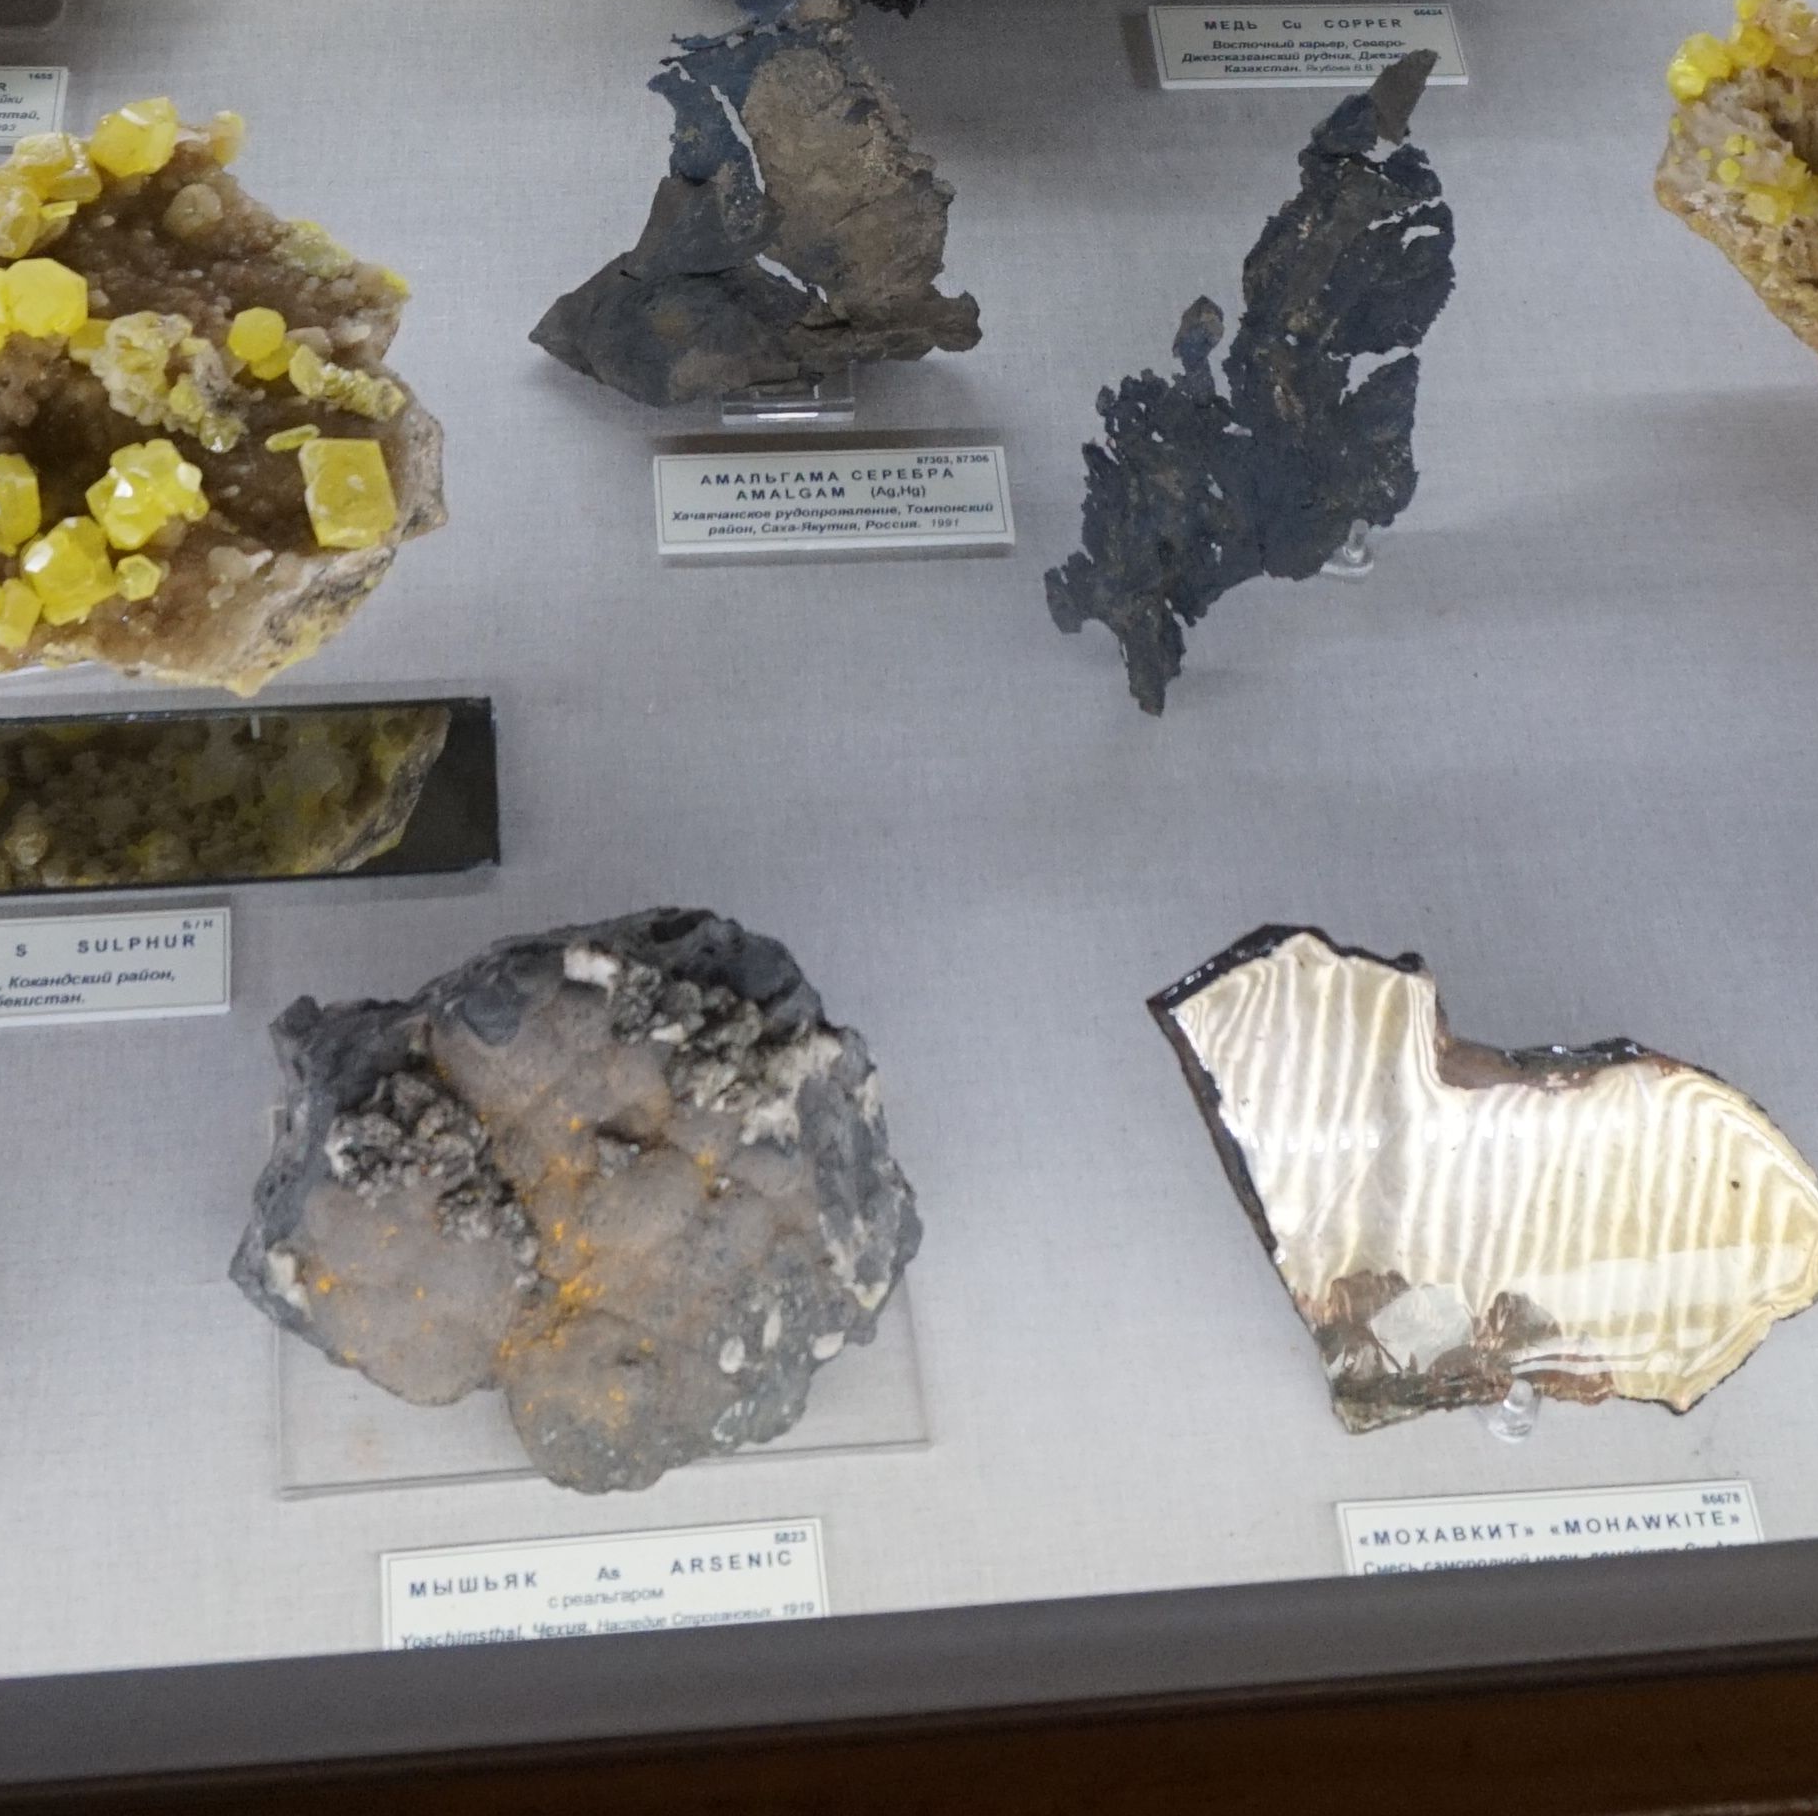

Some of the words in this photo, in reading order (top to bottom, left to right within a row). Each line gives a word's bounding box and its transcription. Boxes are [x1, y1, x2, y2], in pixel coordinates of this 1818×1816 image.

[1204, 20, 1258, 31] МЕДЬ
[1282, 19, 1302, 29] Cu
[1324, 18, 1403, 29] COPPER
[1212, 39, 1295, 50] Восточный
[1224, 64, 1301, 74] Казахстан.
[700, 470, 840, 485] АМАЛЬГАМА
[851, 468, 954, 481] СЕРЕБРА
[736, 486, 846, 501] AMALGAM
[708, 524, 757, 537] район,
[15, 943, 28, 958] S
[77, 933, 197, 955] SULPHUR
[8, 969, 112, 991] Кокандский
[117, 968, 177, 986] район,
[1358, 1522, 1535, 1547] «МОХАВКИТ»
[1549, 1509, 1742, 1537] «MOHAWKITE»
[408, 1570, 540, 1599] МЫШЬЯК
[596, 1565, 622, 1582] As
[669, 1549, 793, 1577] ARSENIC
[547, 1595, 558, 1609] с
[562, 1586, 665, 1611] реальгаром
